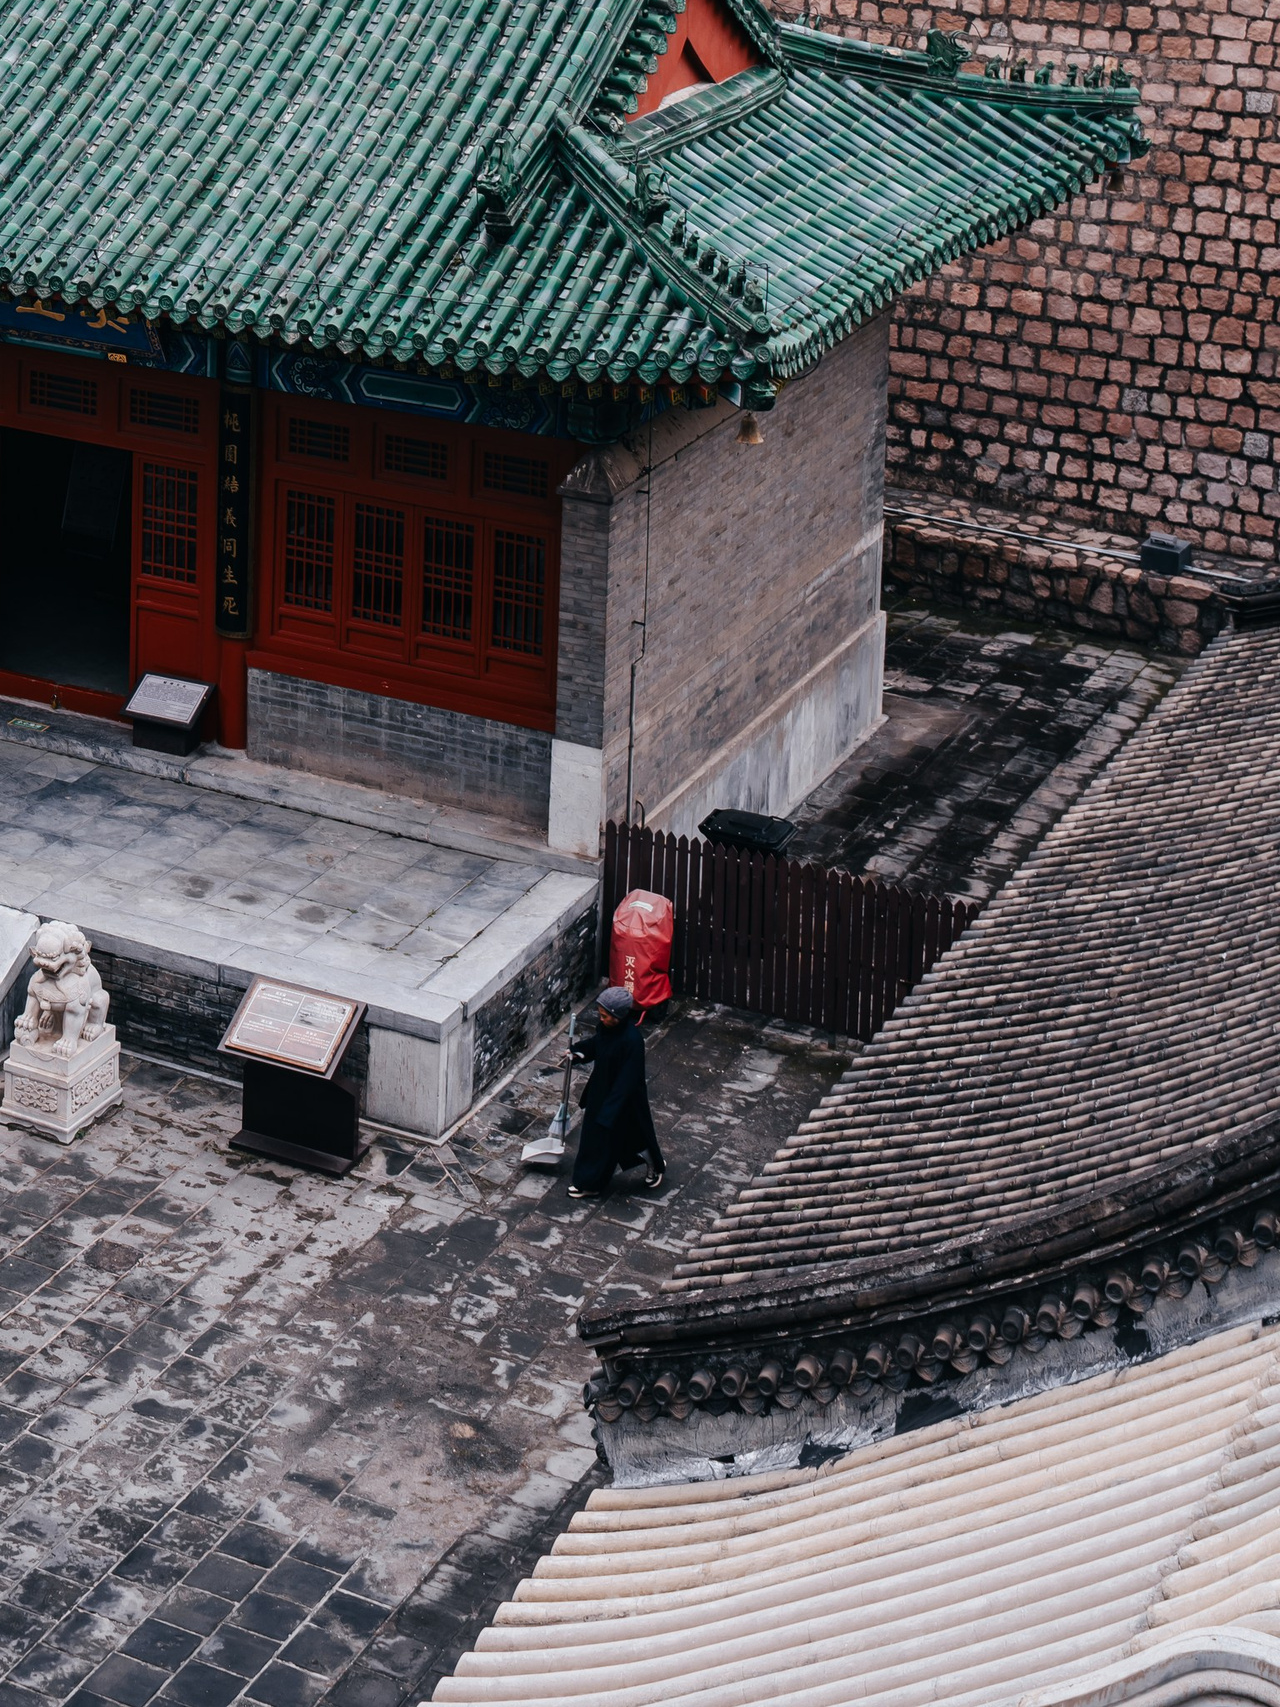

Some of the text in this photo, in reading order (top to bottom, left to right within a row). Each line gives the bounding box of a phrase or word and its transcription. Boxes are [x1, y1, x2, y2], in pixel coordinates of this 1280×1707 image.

[222, 409, 241, 616] 桃園結義同生死
[624, 955, 636, 995] 灭火器
